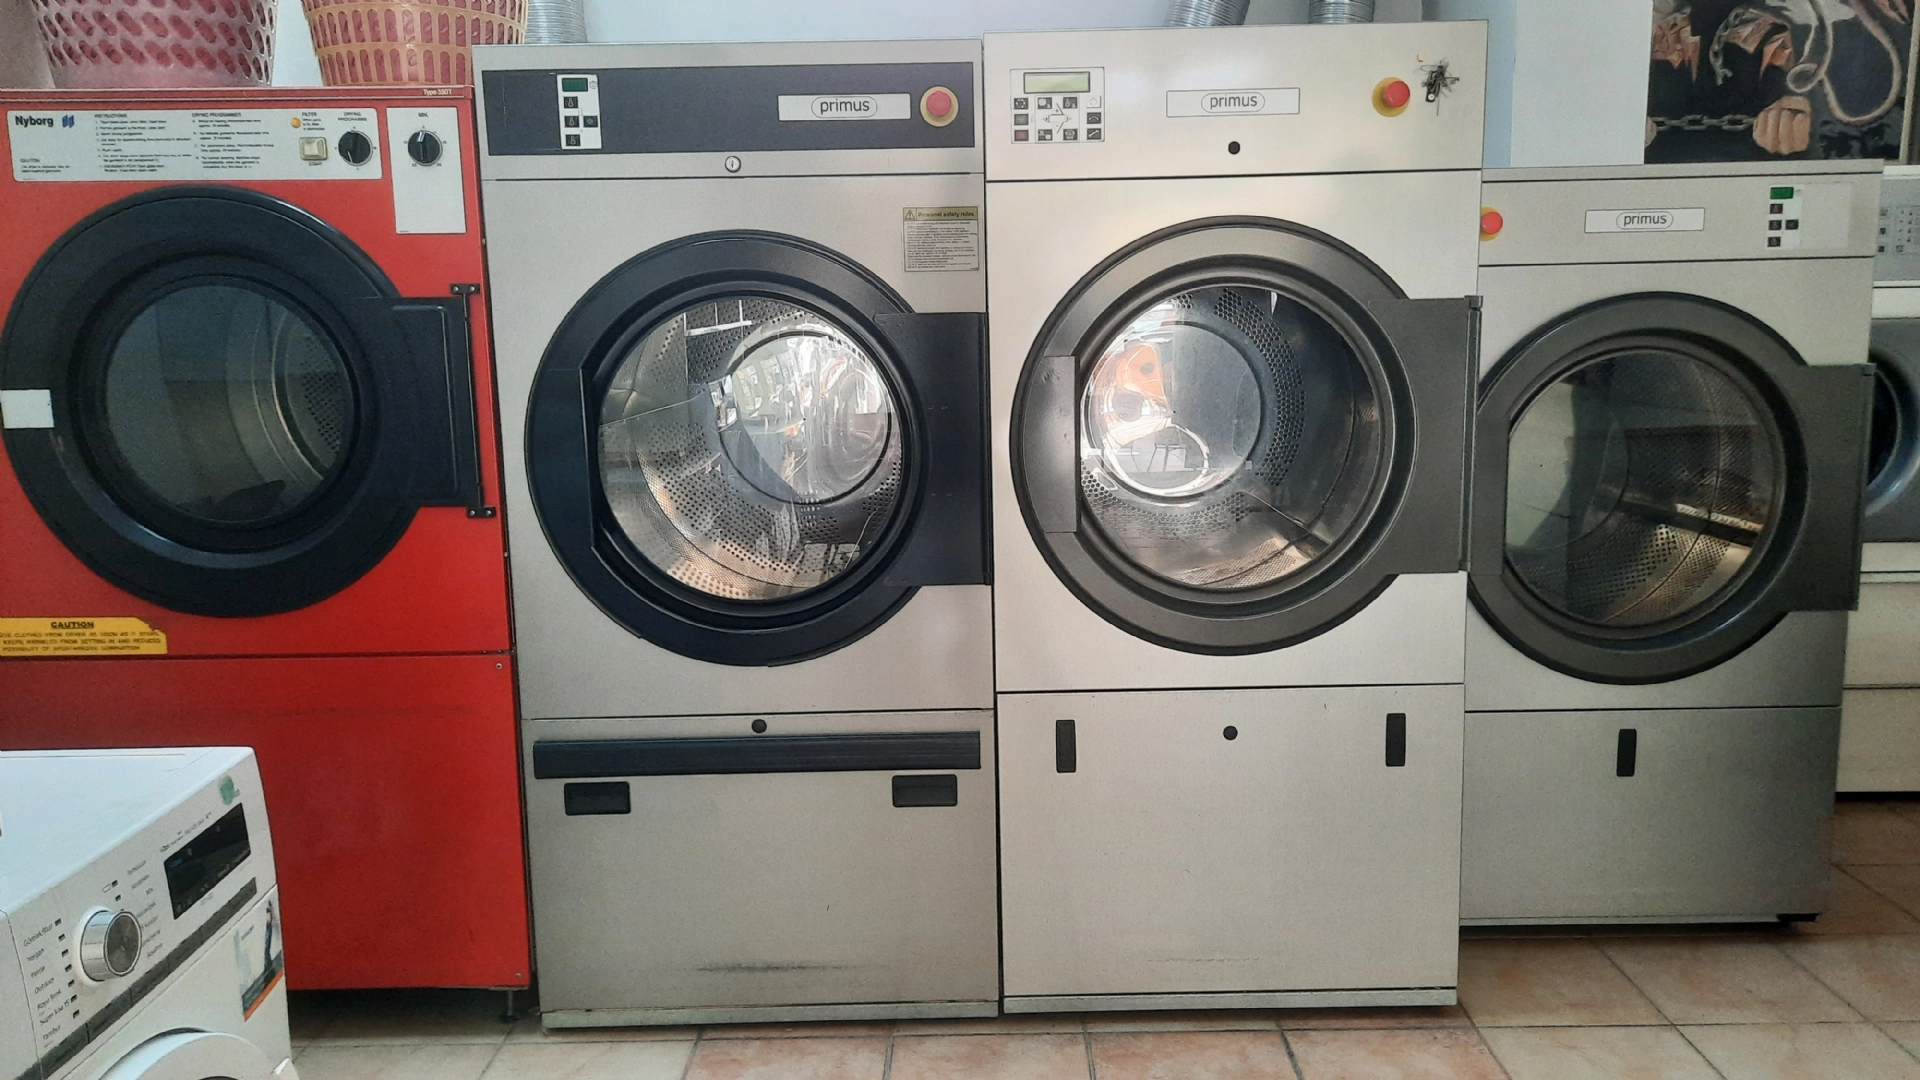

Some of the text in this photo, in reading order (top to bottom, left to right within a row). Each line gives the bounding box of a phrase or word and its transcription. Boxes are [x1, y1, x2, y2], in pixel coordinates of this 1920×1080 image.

[820, 98, 870, 115] primus
[1210, 94, 1258, 110] primus
[15, 115, 54, 128] Nyborg
[1624, 213, 1667, 227] primus
[51, 621, 94, 629] CAUTION
